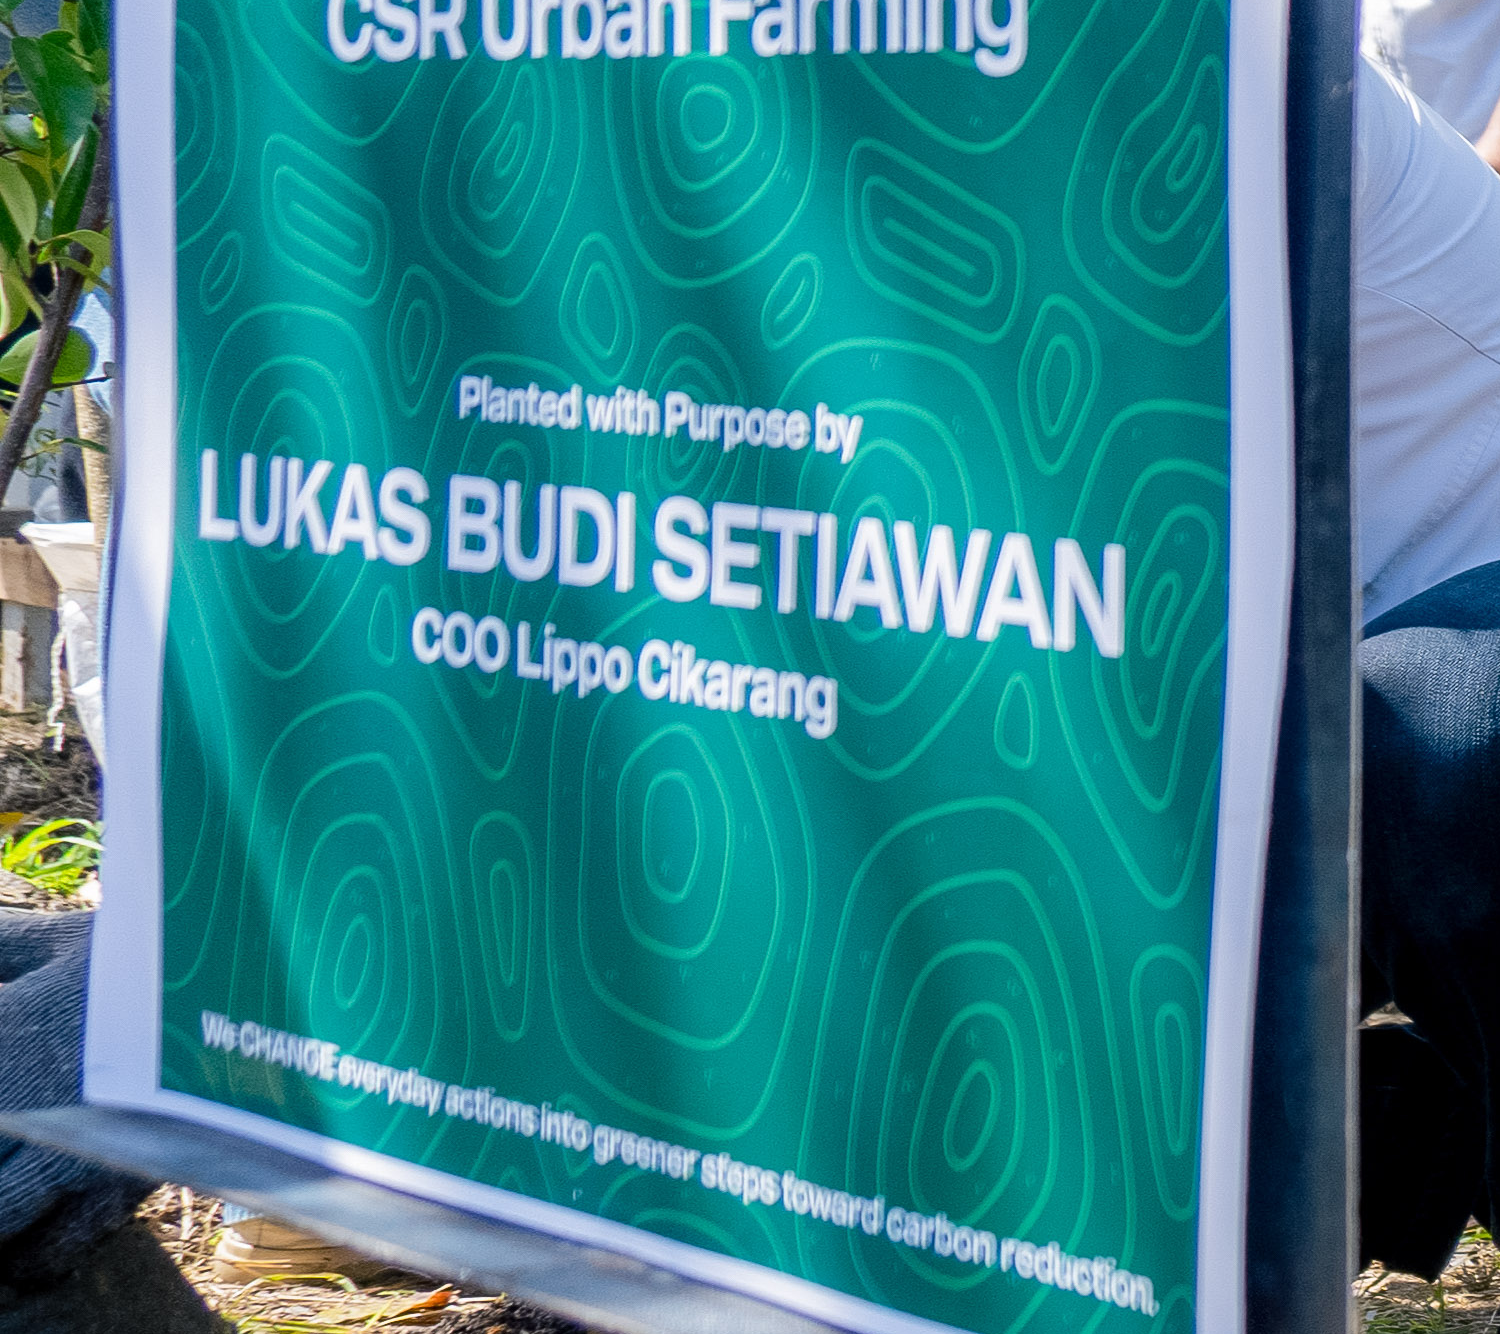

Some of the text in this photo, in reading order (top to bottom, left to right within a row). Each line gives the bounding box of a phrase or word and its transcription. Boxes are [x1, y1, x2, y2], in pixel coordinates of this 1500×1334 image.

[458, 375, 864, 465] Planted with Purpose by
[199, 448, 1127, 660] LUKAS BUDI SETIAWAN
[411, 606, 839, 740] COO Lippo Cikarang
[200, 1009, 1161, 1318] We CHANGE everyday actions into greener steps toward carbon reduction.
